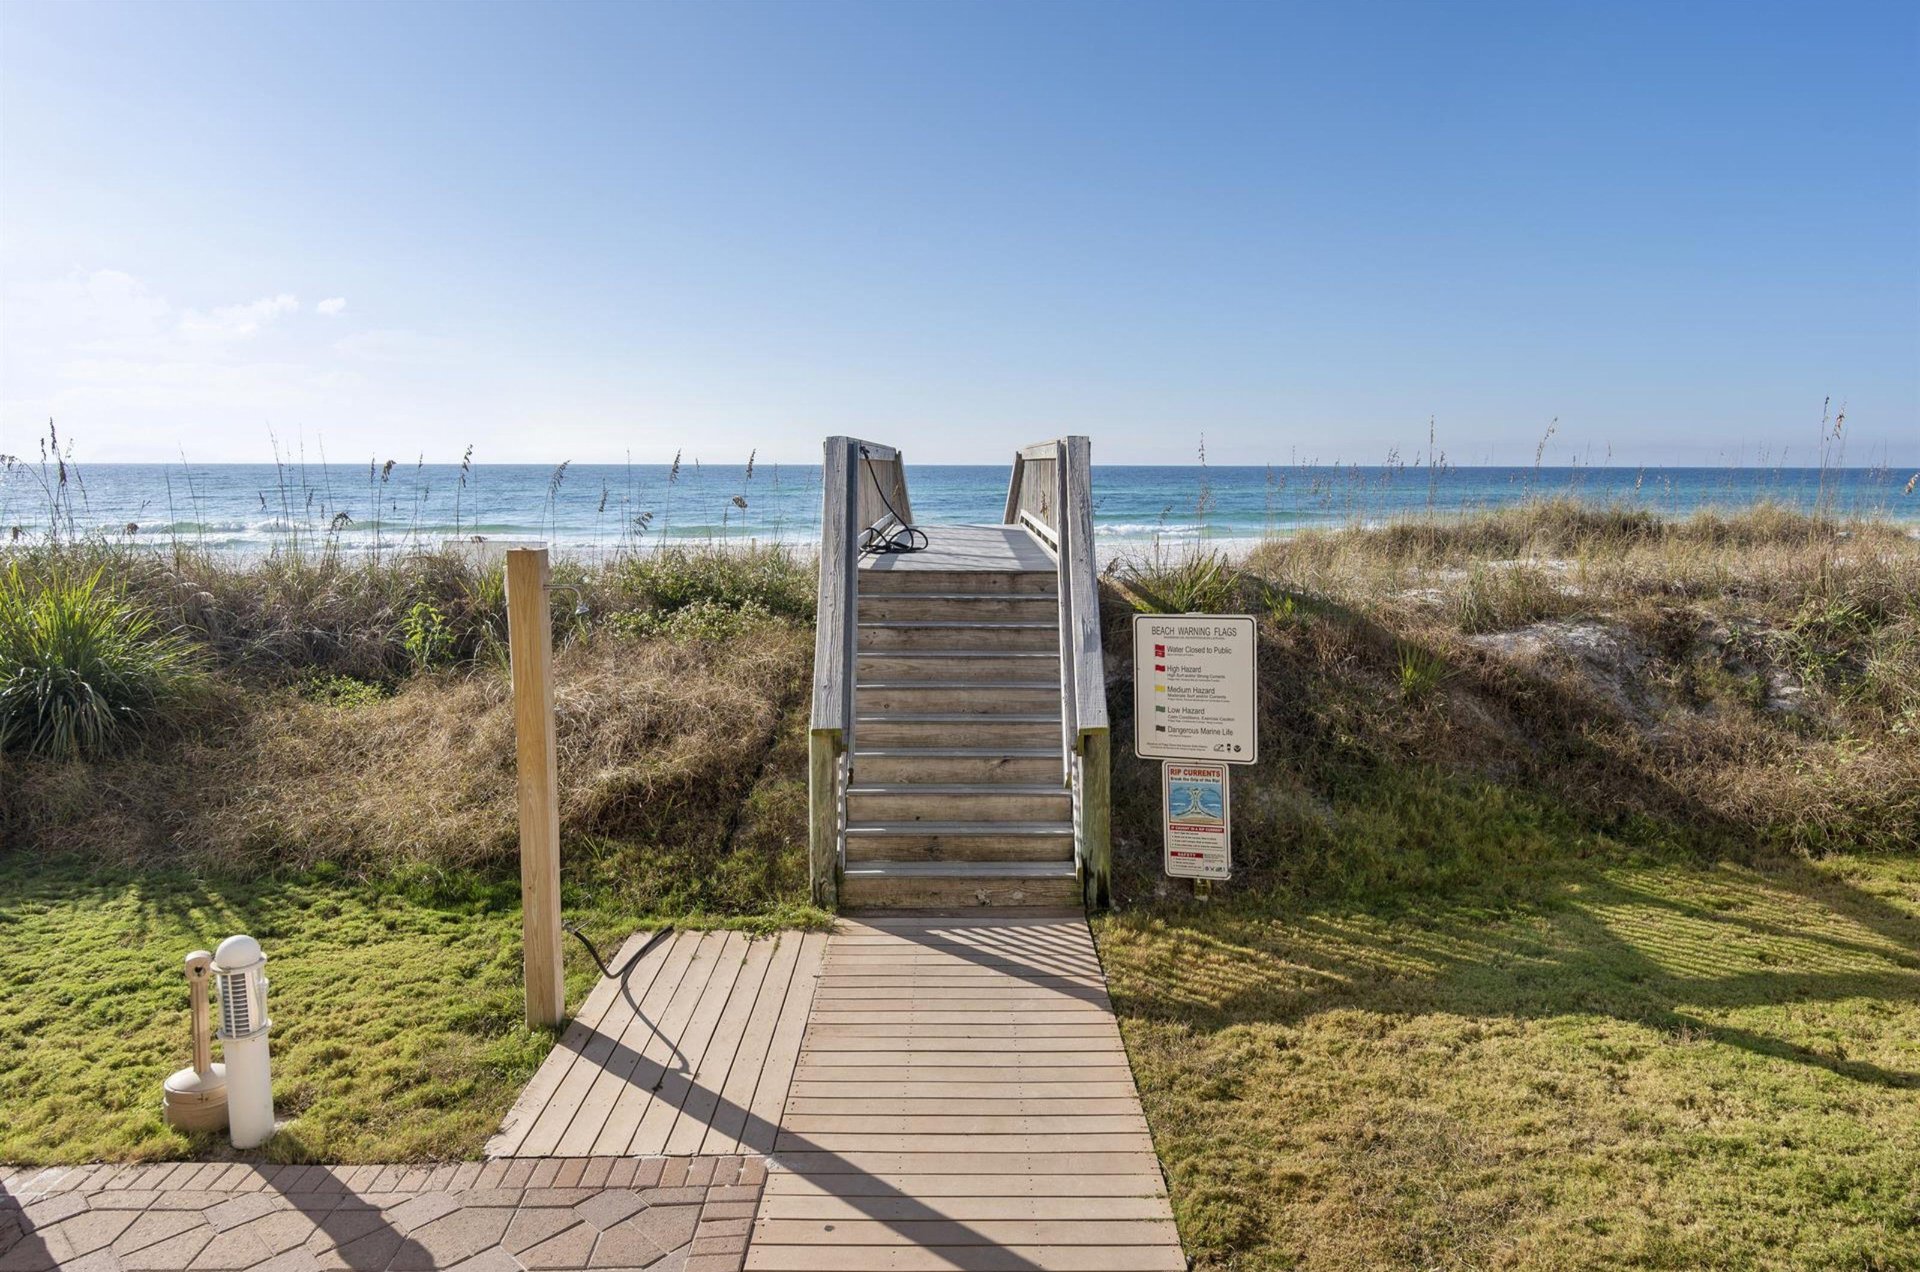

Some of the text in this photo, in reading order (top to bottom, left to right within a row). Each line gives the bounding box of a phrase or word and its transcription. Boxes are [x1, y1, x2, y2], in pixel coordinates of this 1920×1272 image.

[1151, 626, 1237, 637] BEACH WARNING FLAGS
[1185, 646, 1205, 654] Closed
[1167, 665, 1202, 674] High Hazard
[1193, 686, 1216, 694] Hazard
[1182, 706, 1205, 714] Hazard
[1168, 726, 1233, 736] Dangerous Marine Life
[1170, 768, 1221, 778] RIP CURRENTS
